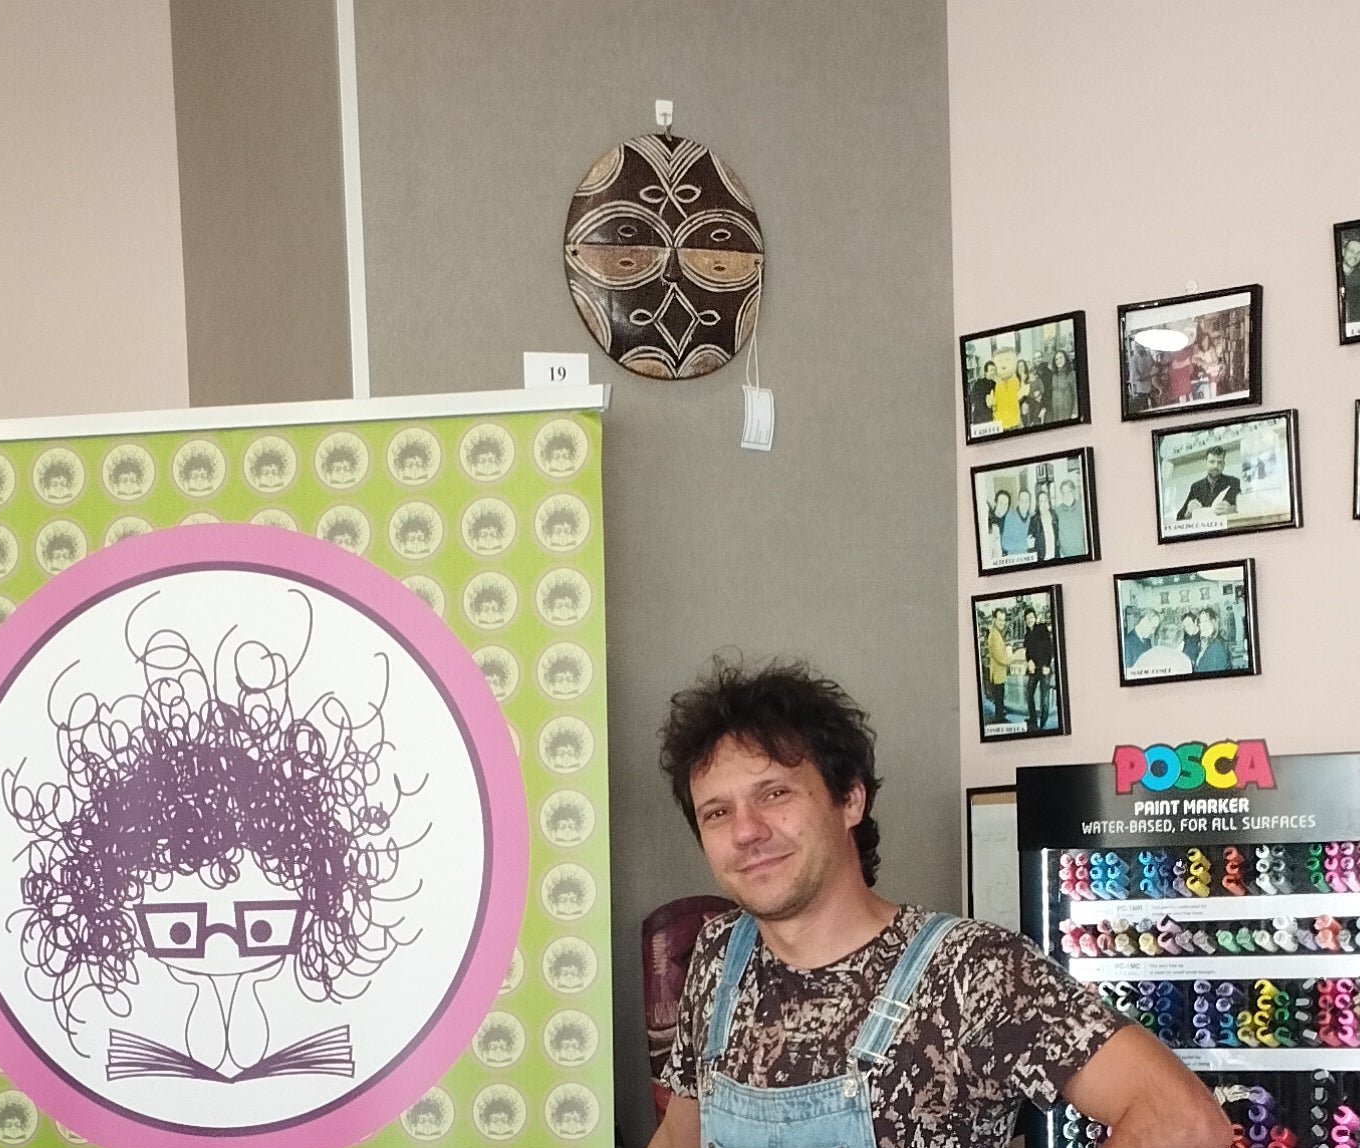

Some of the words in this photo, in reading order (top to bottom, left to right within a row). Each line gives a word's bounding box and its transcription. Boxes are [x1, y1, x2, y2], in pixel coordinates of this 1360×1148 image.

[548, 366, 567, 382] 19
[1112, 738, 1277, 795] POSCA
[1134, 800, 1179, 816] PAINT
[1183, 798, 1249, 814] MARKER
[1082, 818, 1176, 835] WATER-BASED,
[1180, 818, 1208, 832] FOR
[1212, 817, 1237, 831] ALL
[1242, 814, 1316, 830] SURFACES
